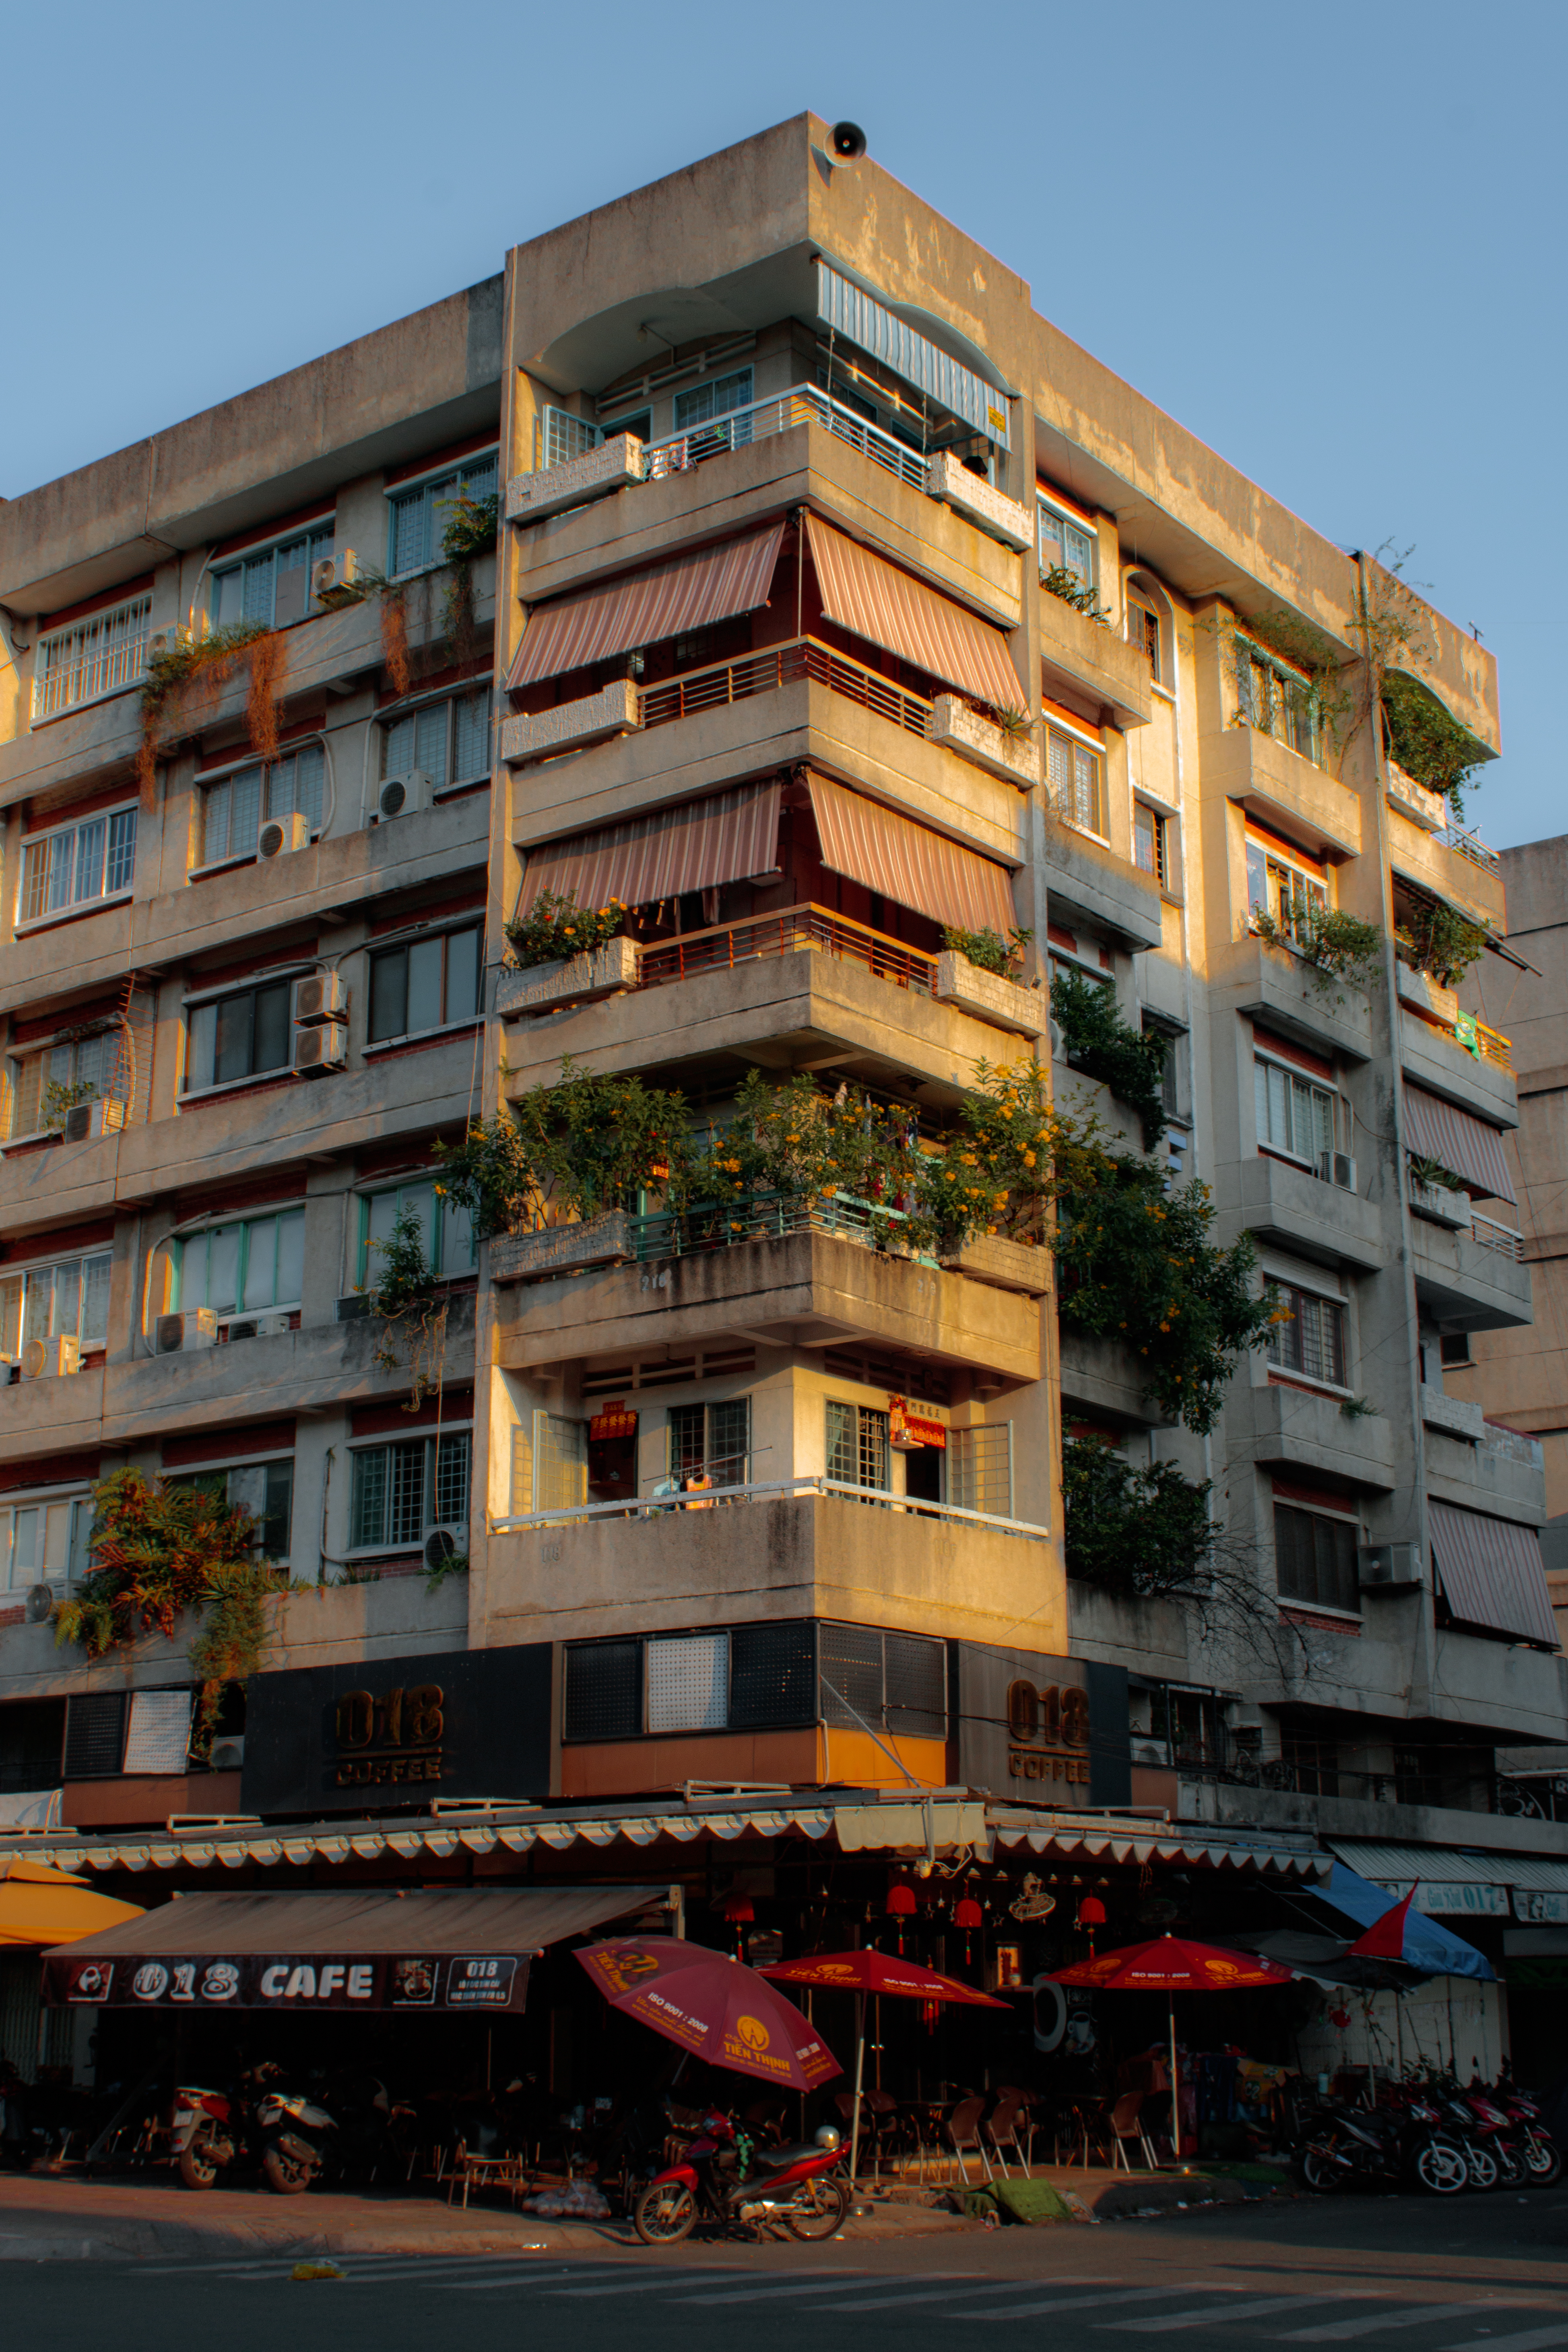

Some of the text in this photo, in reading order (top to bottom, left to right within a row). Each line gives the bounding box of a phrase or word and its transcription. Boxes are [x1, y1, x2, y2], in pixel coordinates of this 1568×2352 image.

[641, 1272, 666, 1291] 218
[336, 1684, 444, 1749] 018
[1007, 1679, 1091, 1748] 018
[336, 1757, 442, 1786] COFFEE
[1009, 1754, 1091, 1783] COFFEE
[1463, 1886, 1496, 1912] 017
[132, 1962, 373, 2001] 018 CAFE
[466, 1960, 499, 1978] 018
[596, 1951, 617, 1970] TIẾN
[608, 1969, 631, 1991] THỊNH
[648, 1992, 665, 2006] ISO
[663, 2002, 684, 2018] 9001
[687, 2017, 709, 2033] 2008
[723, 2041, 751, 2059] TIẾN
[753, 2051, 790, 2071] THỊNH
[1244, 2081, 1261, 2100] C2
